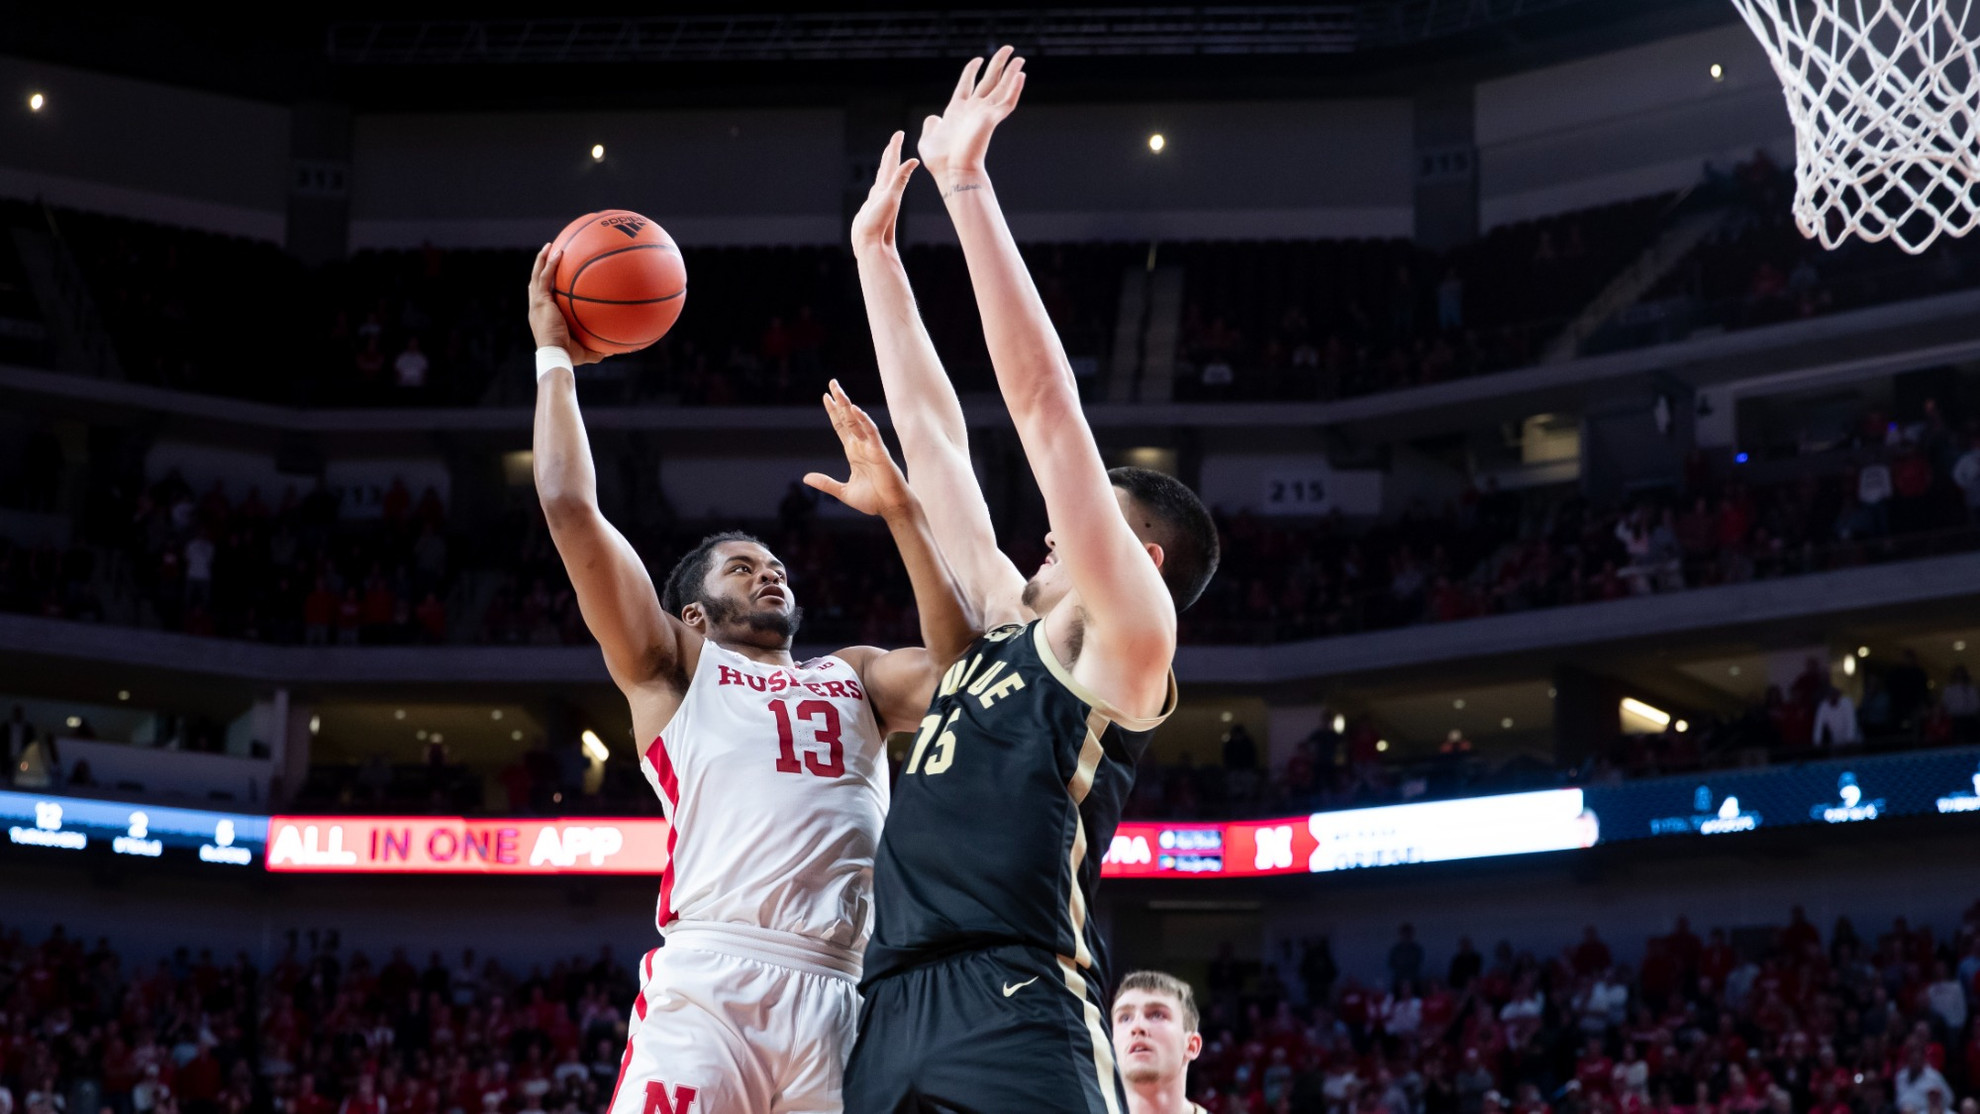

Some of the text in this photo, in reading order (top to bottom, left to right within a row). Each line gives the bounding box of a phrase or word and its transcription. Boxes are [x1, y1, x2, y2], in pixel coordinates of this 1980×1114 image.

[1268, 479, 1325, 502] 215
[768, 699, 845, 778] 13
[905, 701, 961, 775] 15
[267, 825, 357, 866] ALL
[369, 828, 411, 862] IN
[428, 828, 521, 865] ONE
[530, 826, 624, 867] APP
